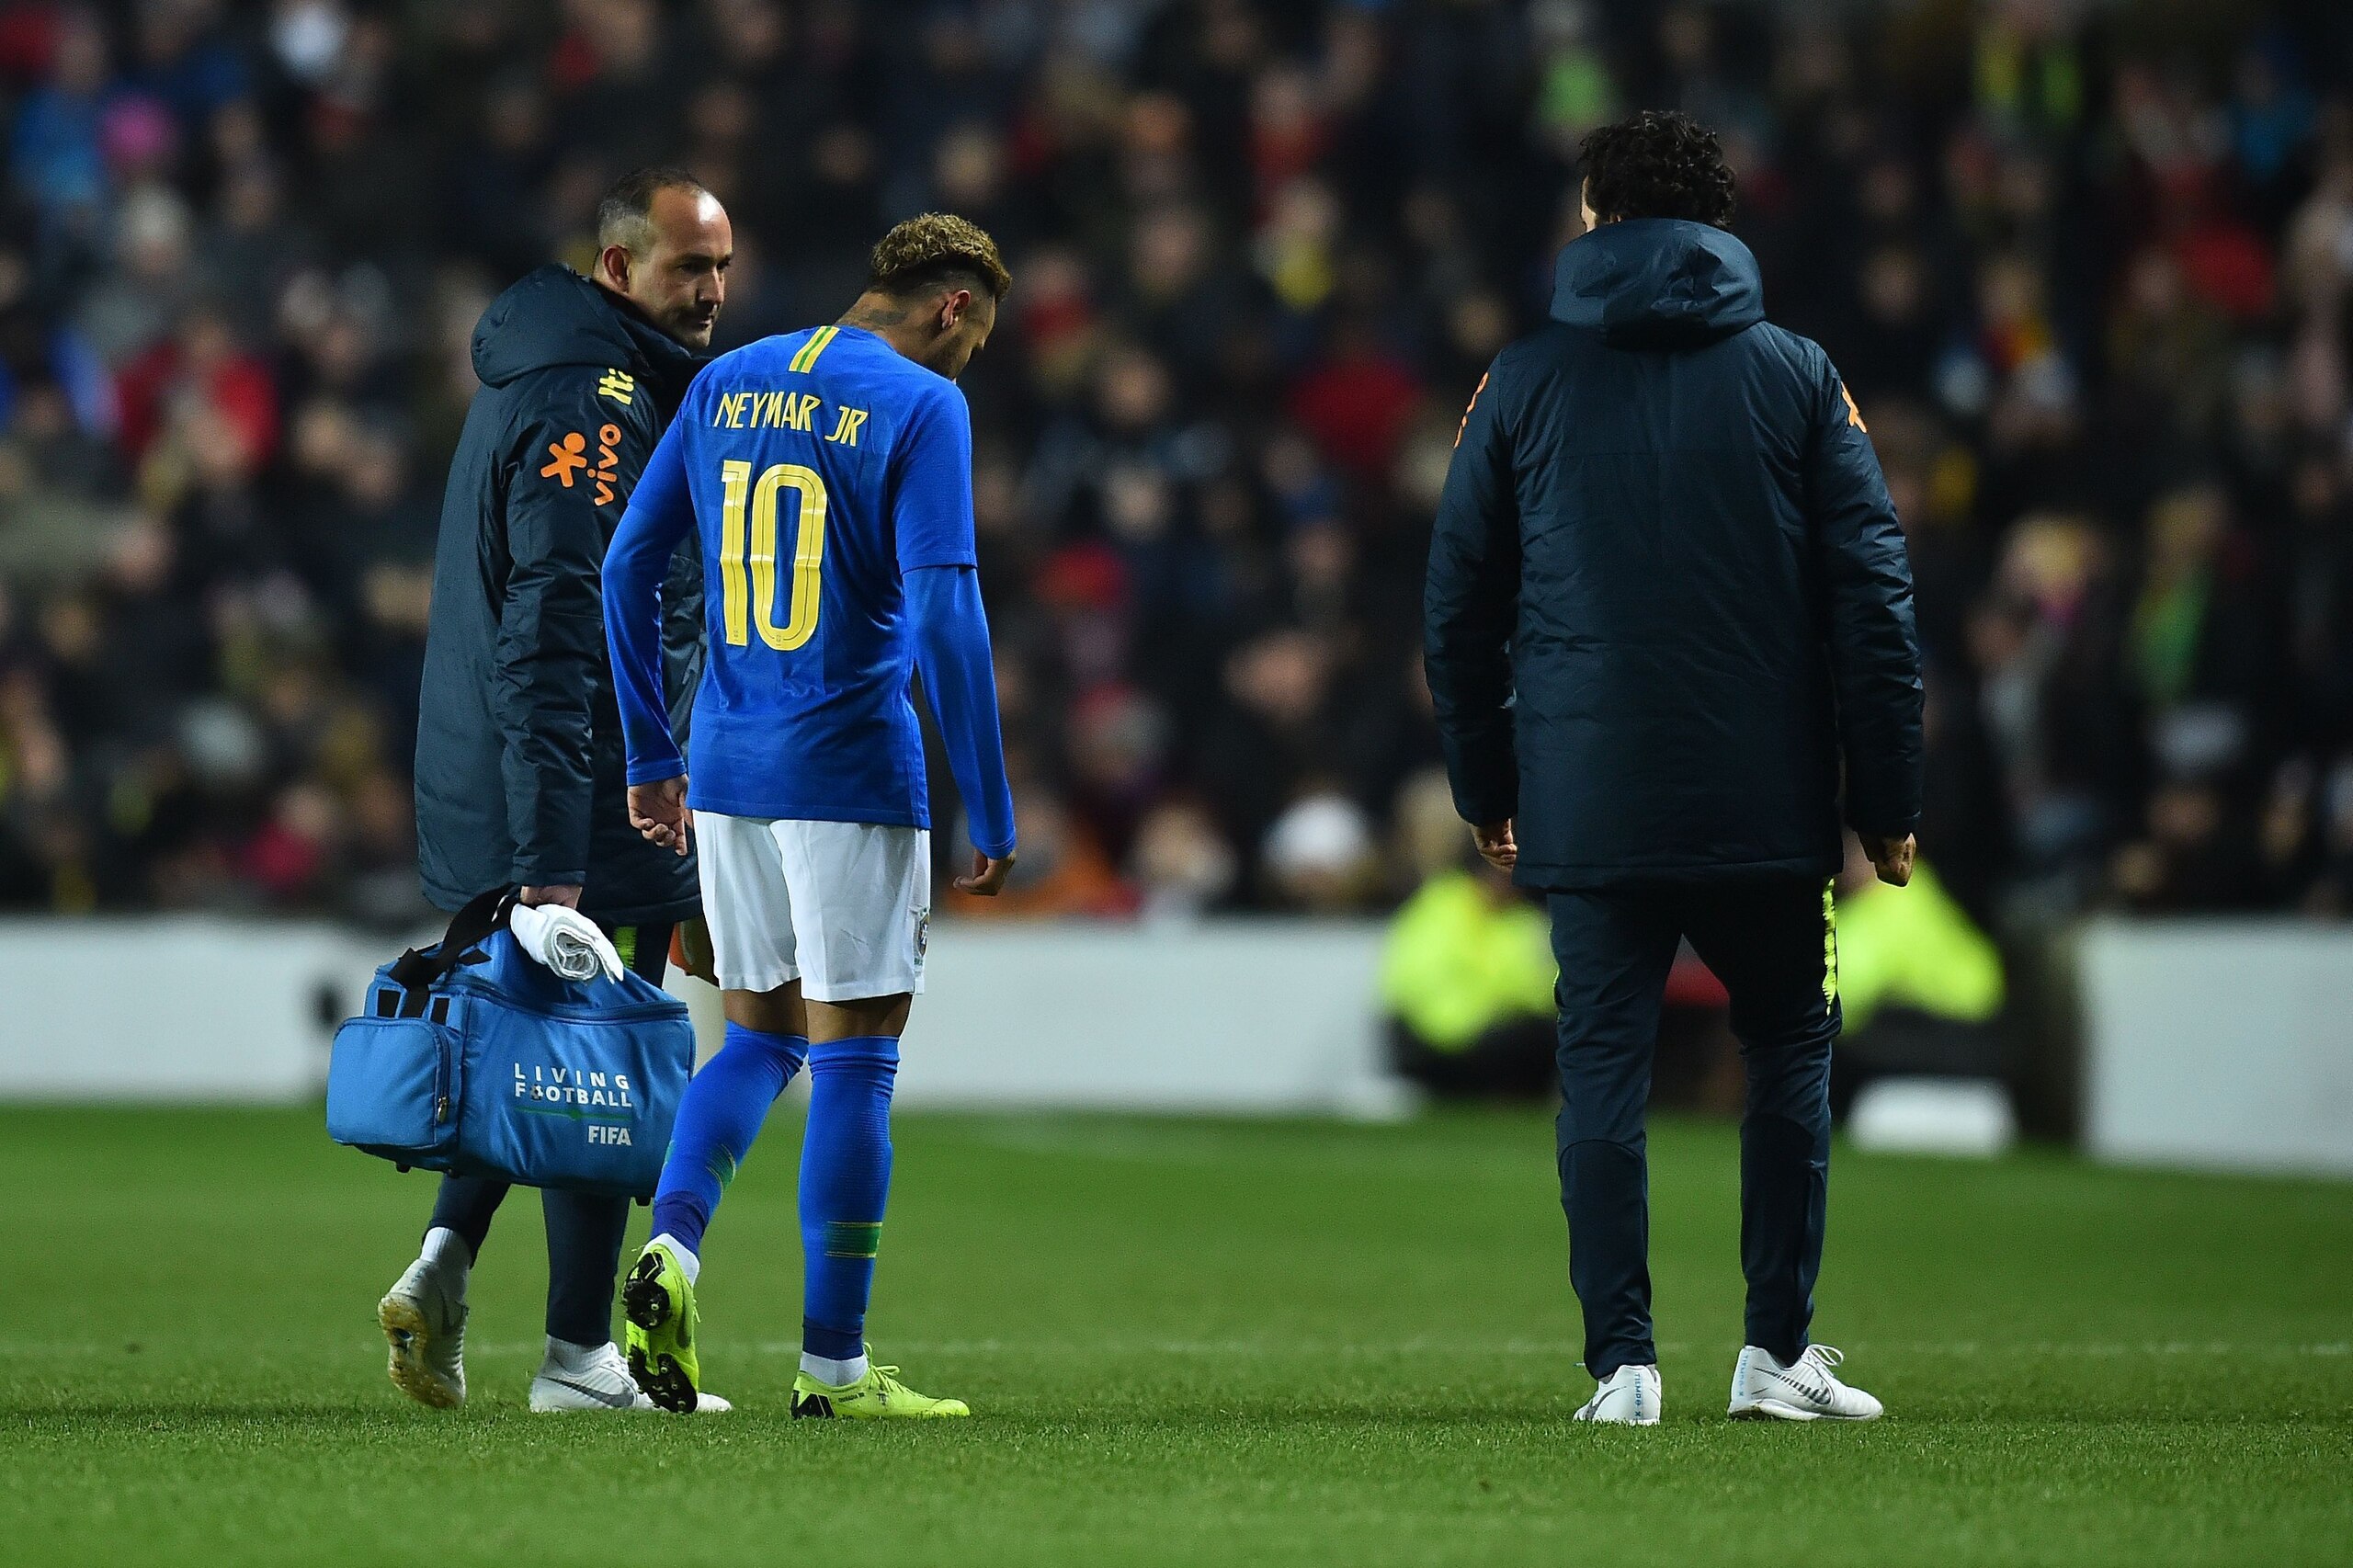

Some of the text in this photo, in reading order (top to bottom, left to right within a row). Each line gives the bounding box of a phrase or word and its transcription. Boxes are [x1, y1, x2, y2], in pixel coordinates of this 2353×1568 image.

[713, 392, 869, 447] NEYMAR JR
[586, 424, 622, 506] vivo
[721, 460, 828, 651] 10
[515, 1062, 630, 1090] LIVING
[588, 1125, 632, 1146] FIFA
